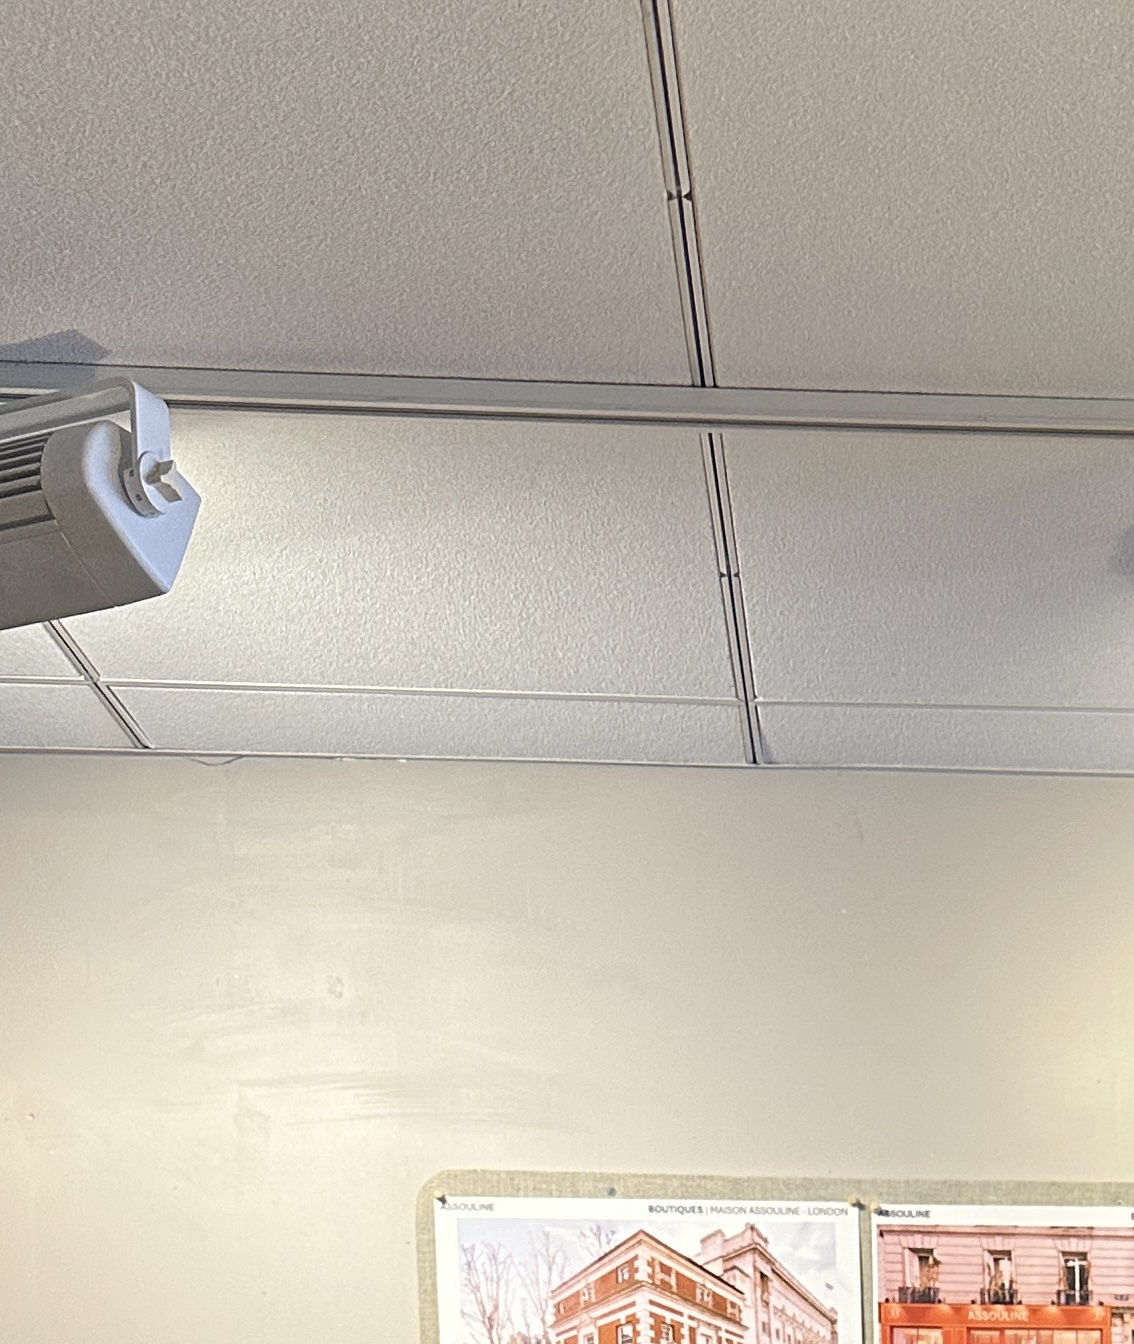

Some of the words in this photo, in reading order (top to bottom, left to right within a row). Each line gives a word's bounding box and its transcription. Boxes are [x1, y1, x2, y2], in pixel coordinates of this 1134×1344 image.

[648, 1204, 704, 1215] BOUTIQUES
[709, 1205, 747, 1215] MAISON
[749, 1206, 800, 1216] ASSOULINE
[807, 1206, 849, 1216] LONDON
[967, 1308, 1030, 1323] ASSOULINE
